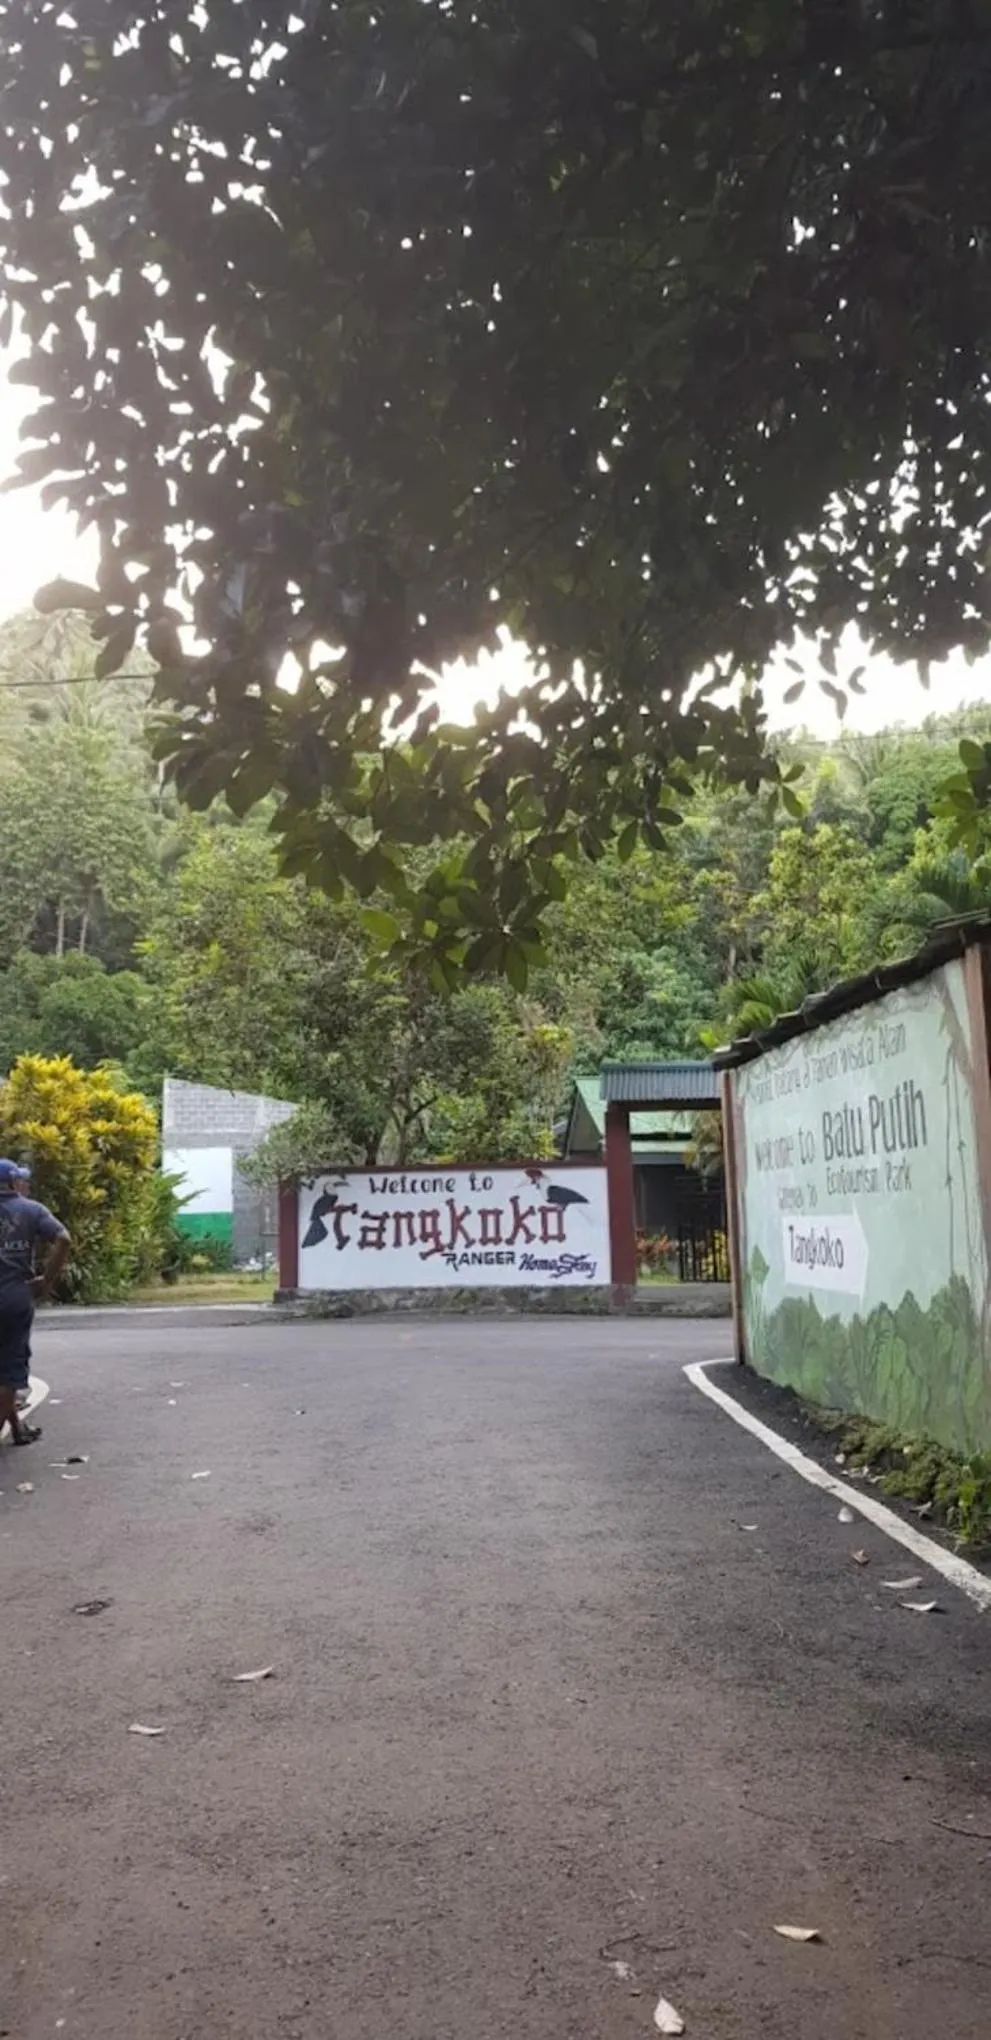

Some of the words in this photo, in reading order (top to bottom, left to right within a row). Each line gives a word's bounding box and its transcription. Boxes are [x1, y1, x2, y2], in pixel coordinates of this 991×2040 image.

[799, 1128, 815, 1165] to
[823, 1102, 866, 1161] Batu
[868, 1080, 927, 1154] Putih
[469, 1171, 494, 1192] to
[885, 1158, 912, 1192] Park
[331, 1195, 568, 1260] Tangkoko
[788, 1224, 844, 1270] Tangkoko
[442, 1251, 516, 1271] RANGER
